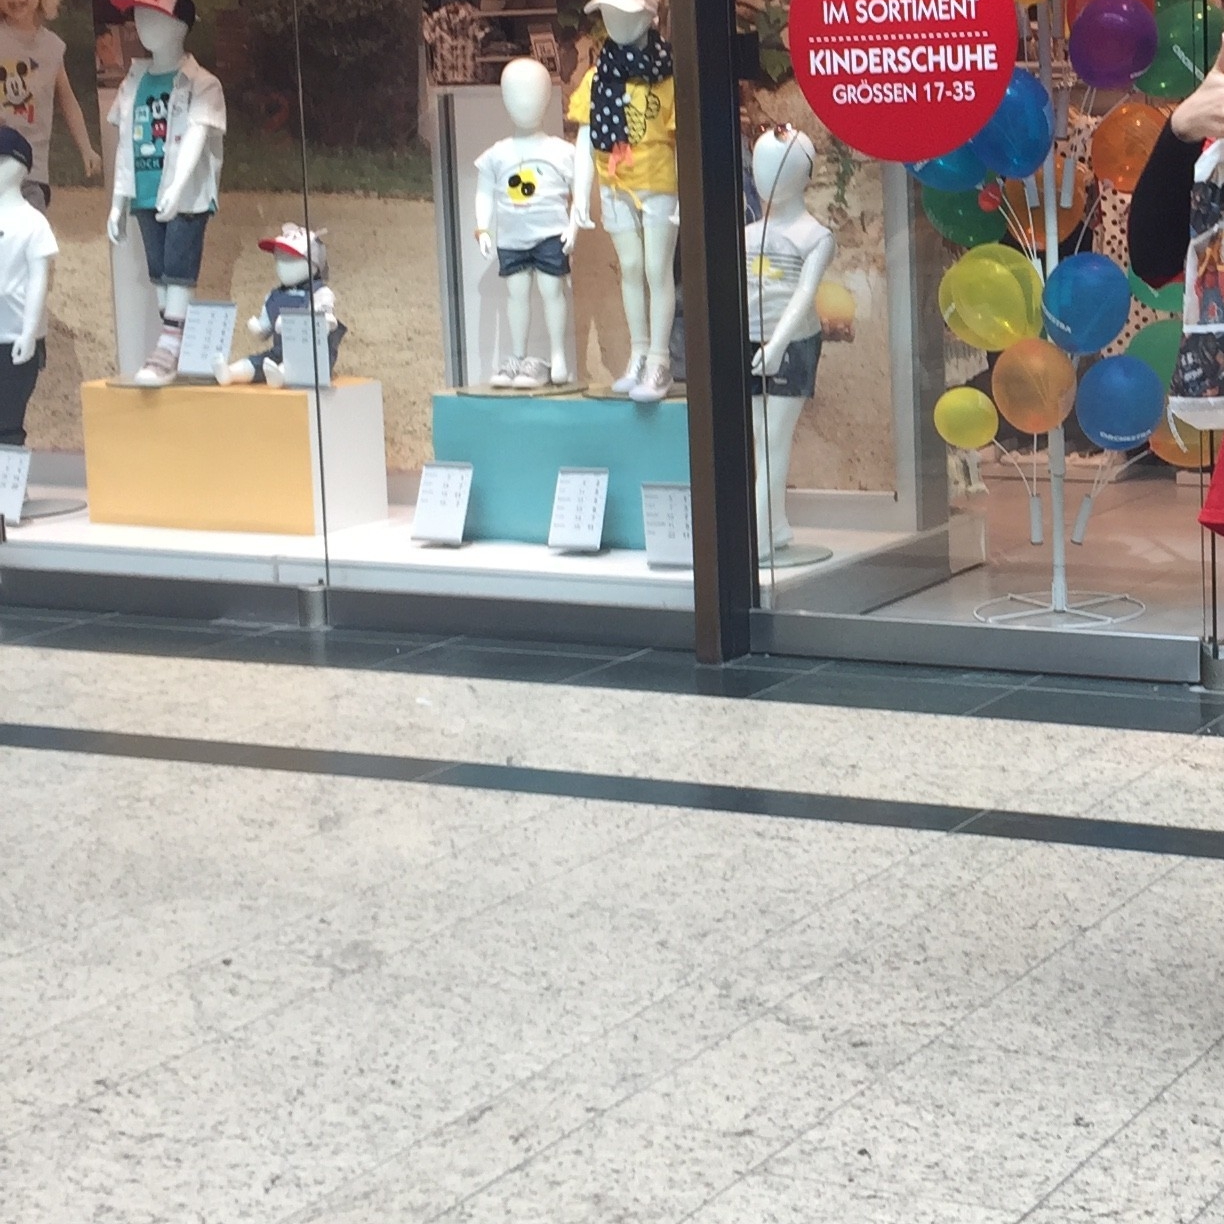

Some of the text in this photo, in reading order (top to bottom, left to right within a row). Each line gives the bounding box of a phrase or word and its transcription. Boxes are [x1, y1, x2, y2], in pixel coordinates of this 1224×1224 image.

[822, 0, 849, 24] IM
[809, 44, 998, 75] KINDERSCHUHE
[832, 79, 975, 104] GRÖSSEN 17-35
